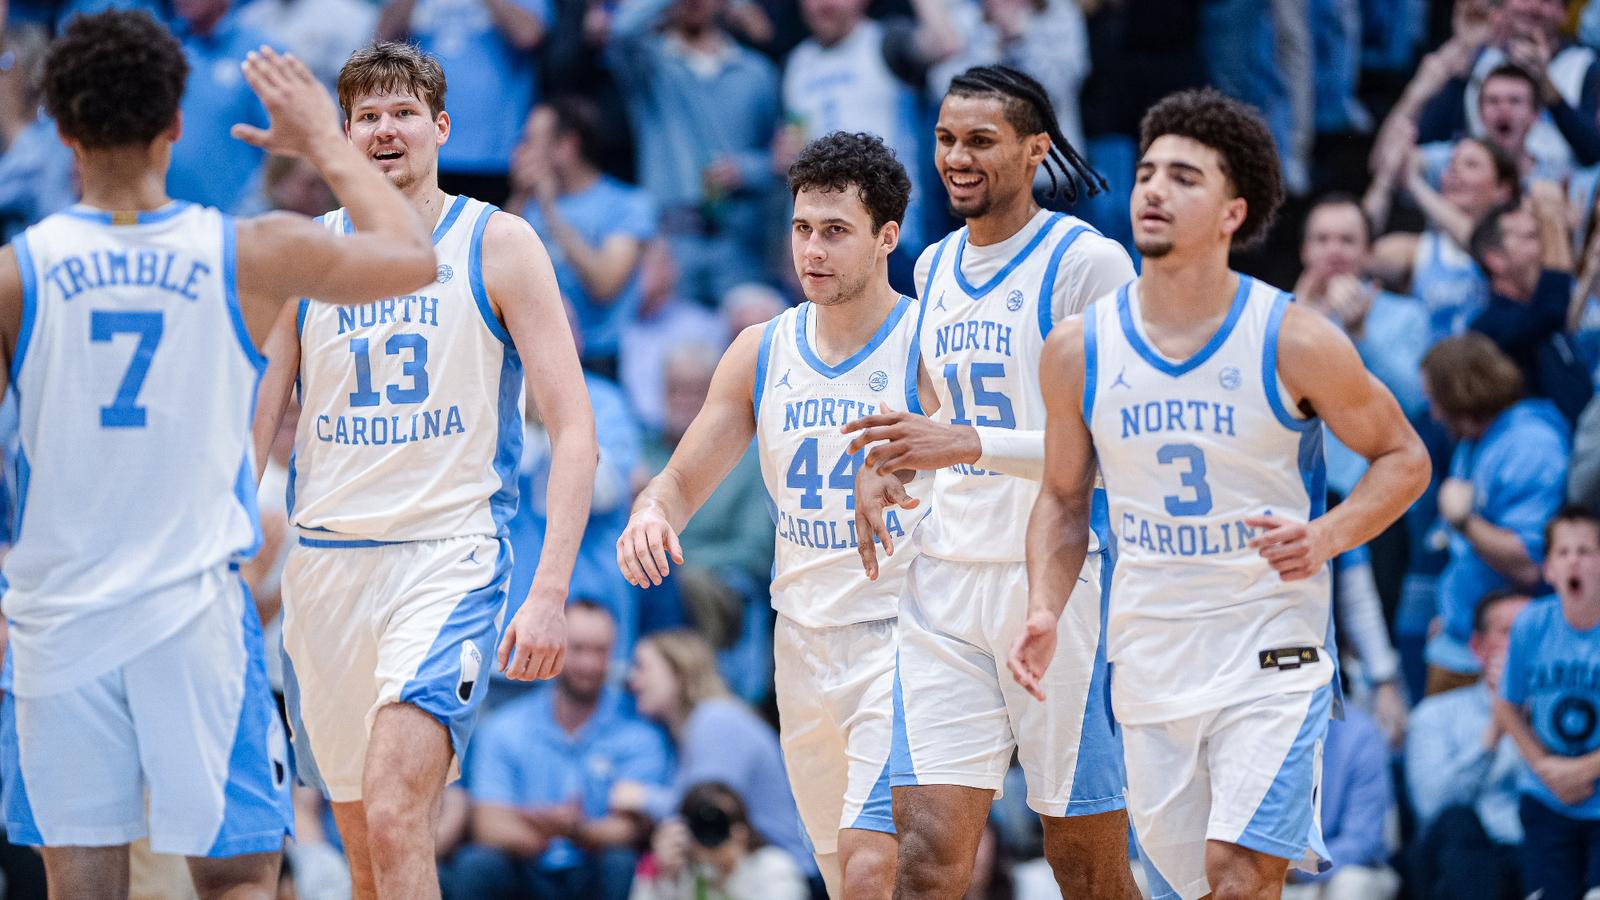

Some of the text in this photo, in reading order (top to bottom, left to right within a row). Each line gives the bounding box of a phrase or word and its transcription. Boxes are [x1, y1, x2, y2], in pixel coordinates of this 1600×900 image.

[46, 250, 211, 300] TRIMBLE
[337, 296, 439, 335] NORTH
[935, 320, 1012, 358] NORTH
[91, 310, 164, 428] 7
[350, 333, 430, 408] 13
[943, 362, 1017, 431] 15
[1120, 399, 1237, 439] NORTH
[316, 405, 466, 446] CAROLINA
[786, 437, 866, 510] 44
[1156, 443, 1214, 518] 3
[778, 510, 905, 549] CAROLIA
[1122, 510, 1273, 556] CAROLIN
